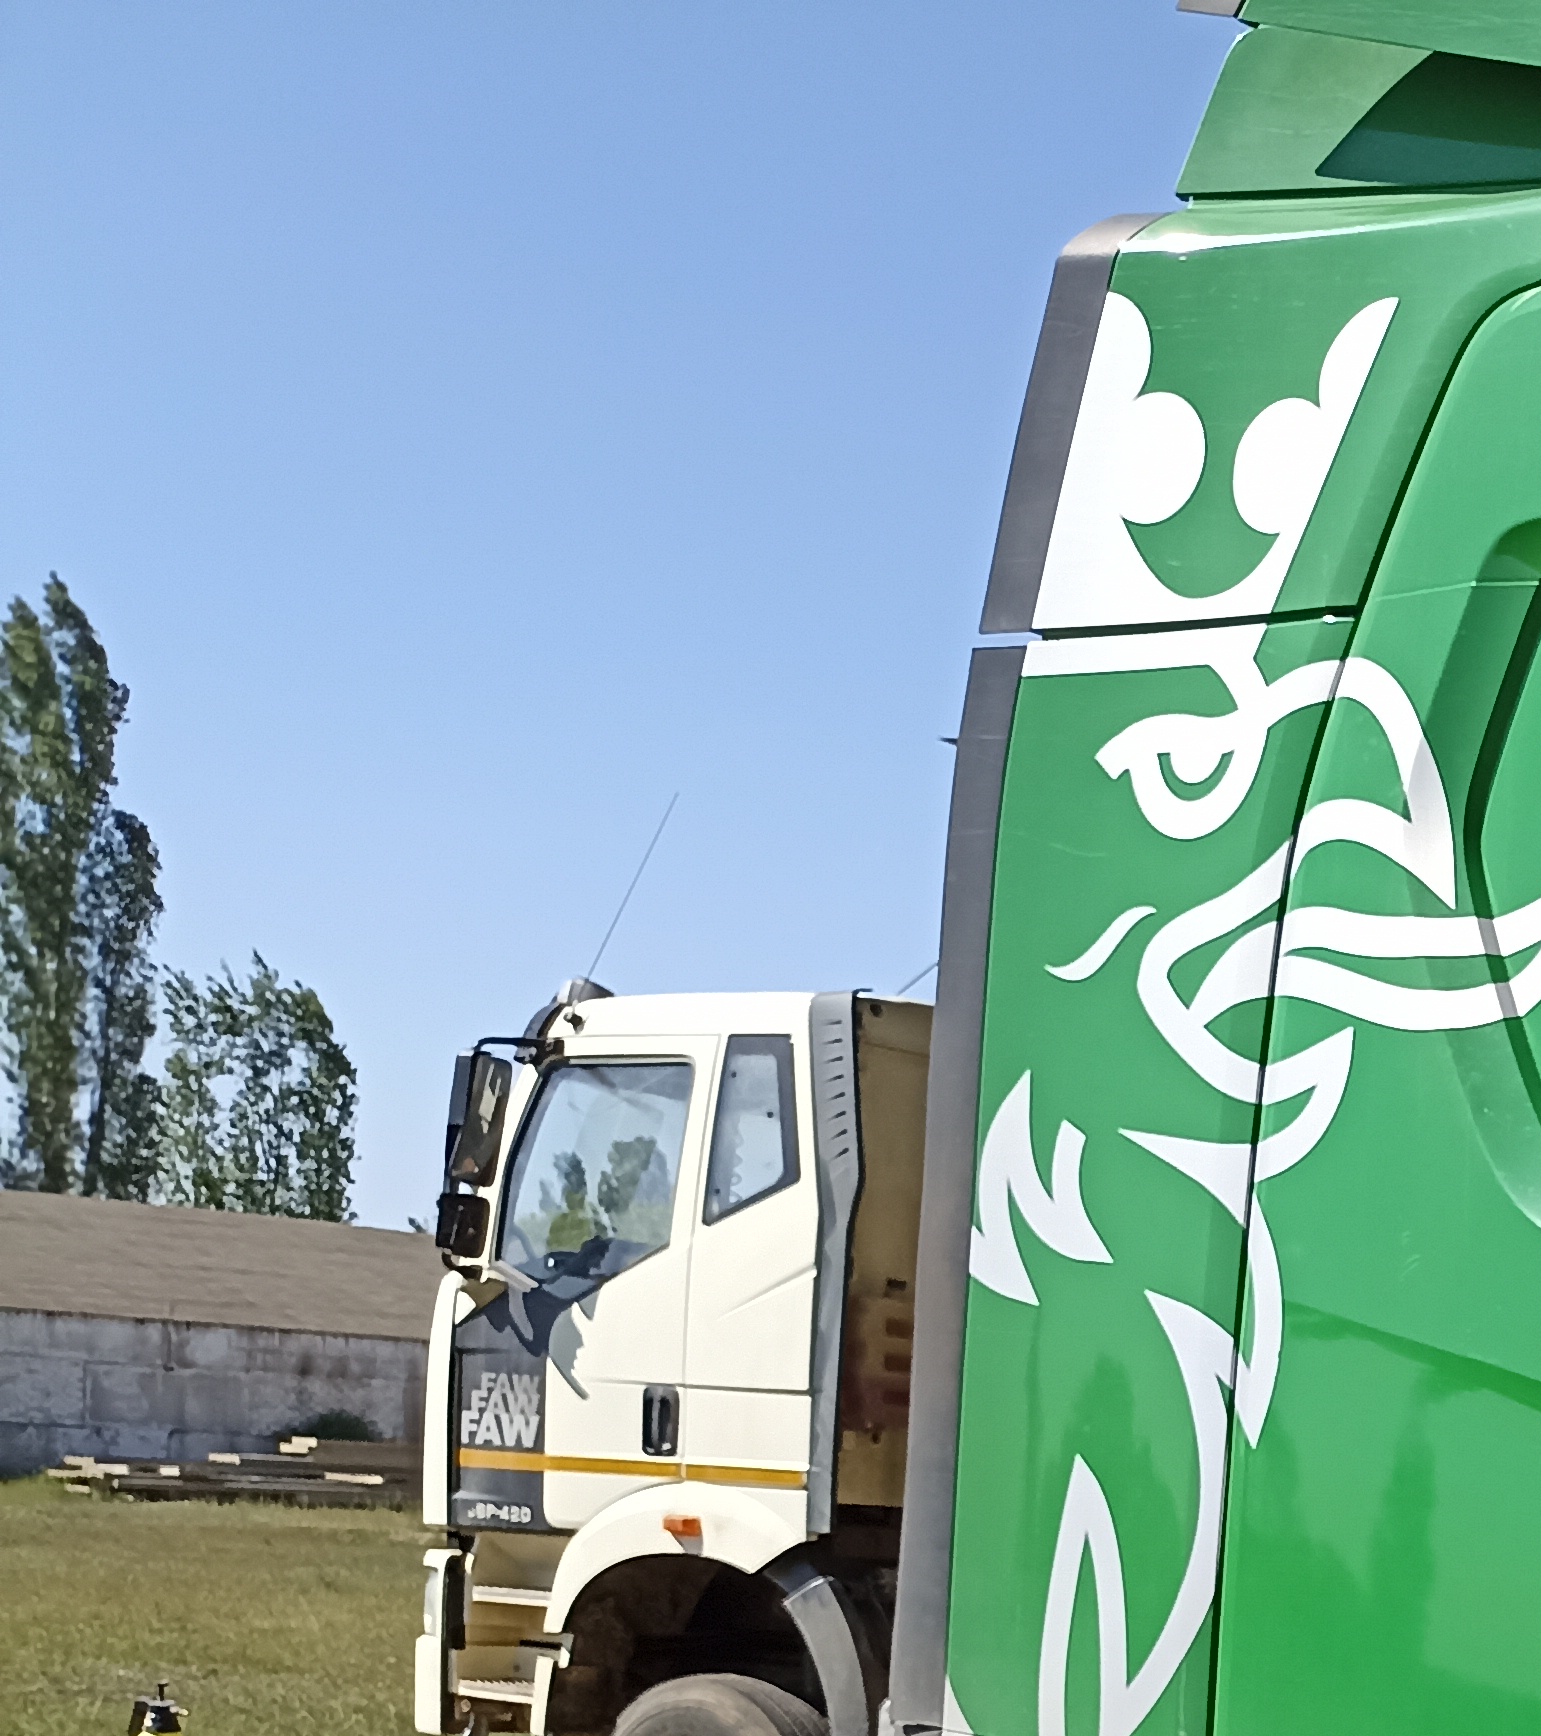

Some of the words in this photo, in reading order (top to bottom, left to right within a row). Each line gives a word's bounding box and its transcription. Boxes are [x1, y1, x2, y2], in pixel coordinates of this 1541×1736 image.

[481, 1372, 540, 1397] FAW
[471, 1389, 541, 1416] FAW
[461, 1410, 541, 1448] FAW
